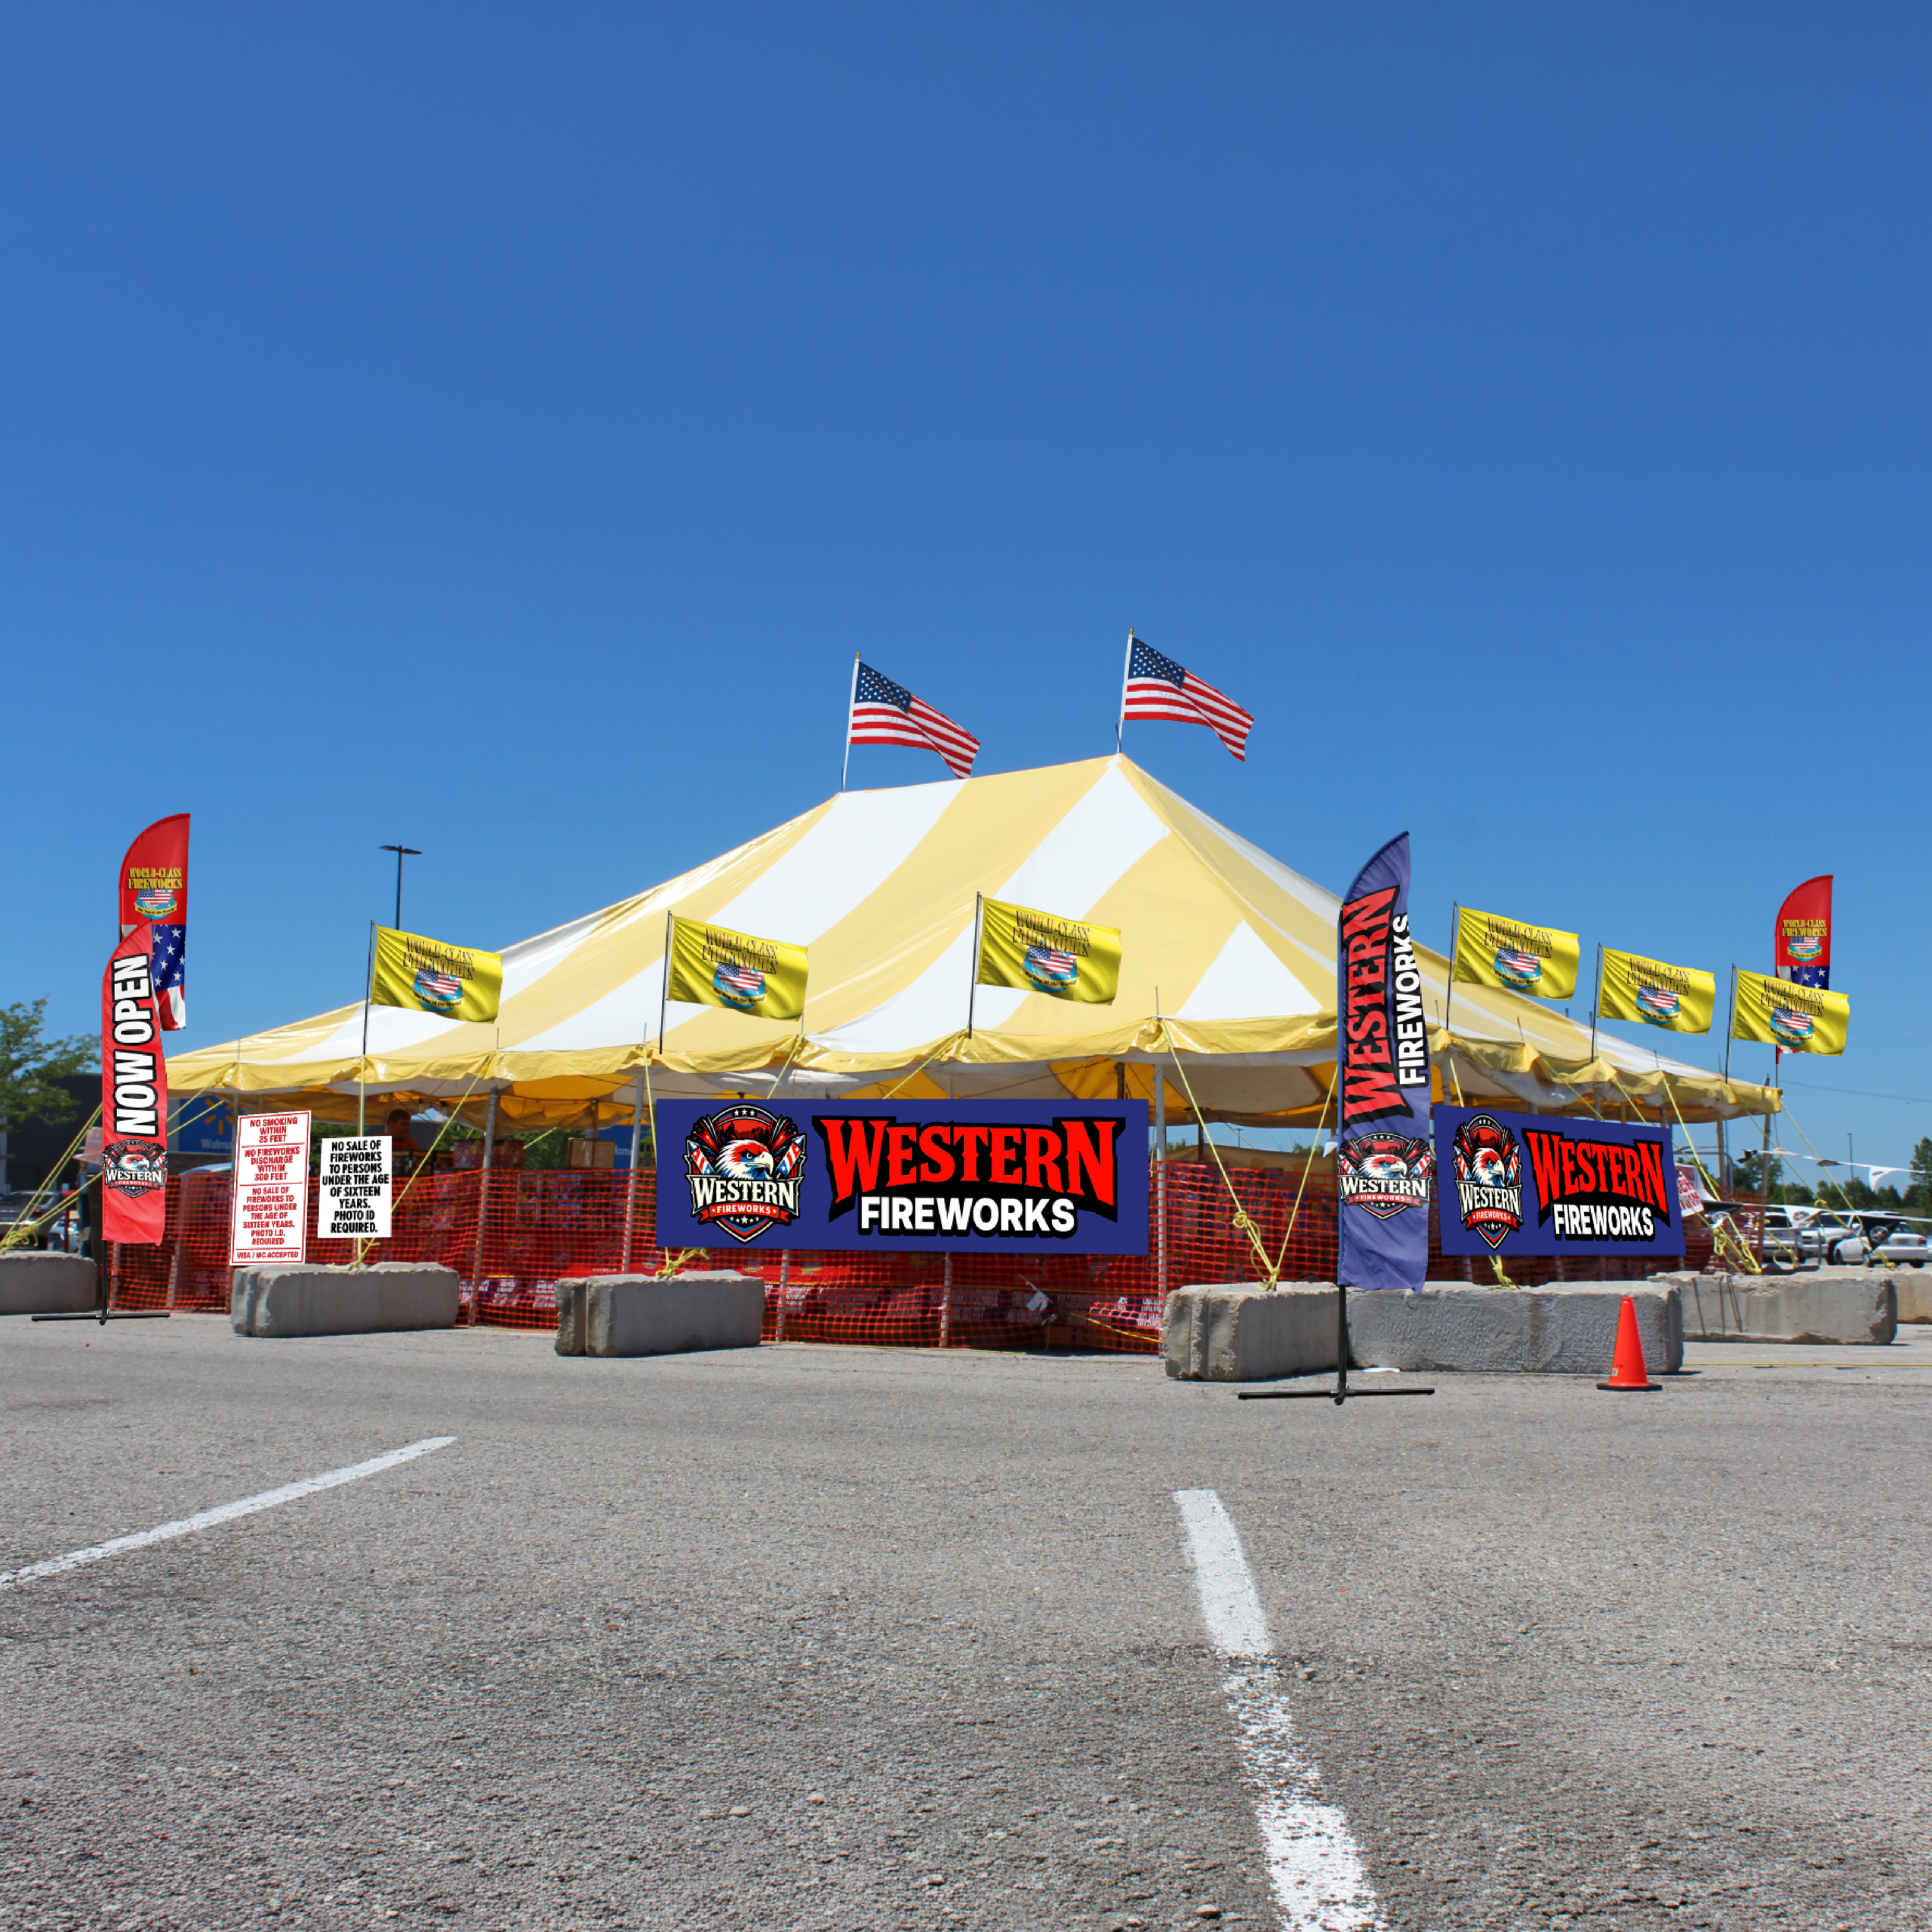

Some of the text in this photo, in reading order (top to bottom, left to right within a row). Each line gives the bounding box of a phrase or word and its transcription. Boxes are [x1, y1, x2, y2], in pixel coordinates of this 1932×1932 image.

[128, 867, 182, 878] WORLD-CLASS
[128, 878, 183, 890] FIREWORKS
[1017, 910, 1091, 942] WORLD-CLASS
[1783, 919, 1826, 928] WORLD-CLASS
[1487, 917, 1552, 945] WORLD-CLASS
[1782, 928, 1827, 937] FIREWORKS
[706, 928, 778, 959] WORLD-CLASS
[1013, 926, 1091, 957] FIREWORKS
[1484, 931, 1552, 958] FIREWORKS
[406, 937, 475, 965] WORLD-CLASS
[703, 944, 779, 974] FIREWORKS
[404, 952, 475, 980] FIREWORKS
[1630, 958, 1690, 983] WORLD-CLASS
[1627, 971, 1690, 996] FIREWORKS
[1764, 980, 1824, 1004] WORLD-CLASS
[1343, 888, 1407, 1121] WESTERN
[1392, 913, 1426, 1084] FIREWORKS
[1761, 992, 1824, 1017] FIREWORKS
[113, 954, 156, 1136] NOW OPEN
[251, 1116, 297, 1128] NO SMOKING
[260, 1126, 287, 1135] WITHIN
[201, 1138, 232, 1149] Walma
[269, 1134, 287, 1143] FEET
[257, 1146, 300, 1156] FIREWORKS
[331, 1140, 381, 1152] NO SALE OF
[251, 1155, 293, 1164] DISCHARGE
[331, 1151, 382, 1162] FIREWORKS
[820, 1119, 1117, 1206] WESTERN
[257, 1164, 285, 1173] WITHIN
[330, 1163, 382, 1174] TO PERSONS
[1526, 1131, 1668, 1215] WESTERN
[106, 1169, 162, 1183] WESTERN
[254, 1172, 288, 1181] 300 FEET
[322, 1174, 389, 1186] UNDER THE AGE
[330, 1186, 380, 1197] OF SIXTEEN
[693, 1177, 795, 1210] WESTERN
[1343, 1177, 1426, 1198] WESTERN
[1360, 1193, 1405, 1201] FIREWORKS
[1459, 1183, 1520, 1216] WESTERN
[243, 1204, 272, 1212] PERSONS
[339, 1198, 371, 1209] YEARS.
[717, 1204, 771, 1214] FIREWORKS
[334, 1210, 375, 1221] PHOTO ID
[861, 1196, 1075, 1232] FIREWORKS
[1476, 1211, 1507, 1220] FIREWORKS
[1553, 1204, 1654, 1236] FIREWORKS
[272, 1220, 295, 1228] YEARS.
[331, 1222, 378, 1233] REQUIRED.
[275, 1229, 285, 1237] I.D.
[251, 1237, 285, 1245] REQUIRED
